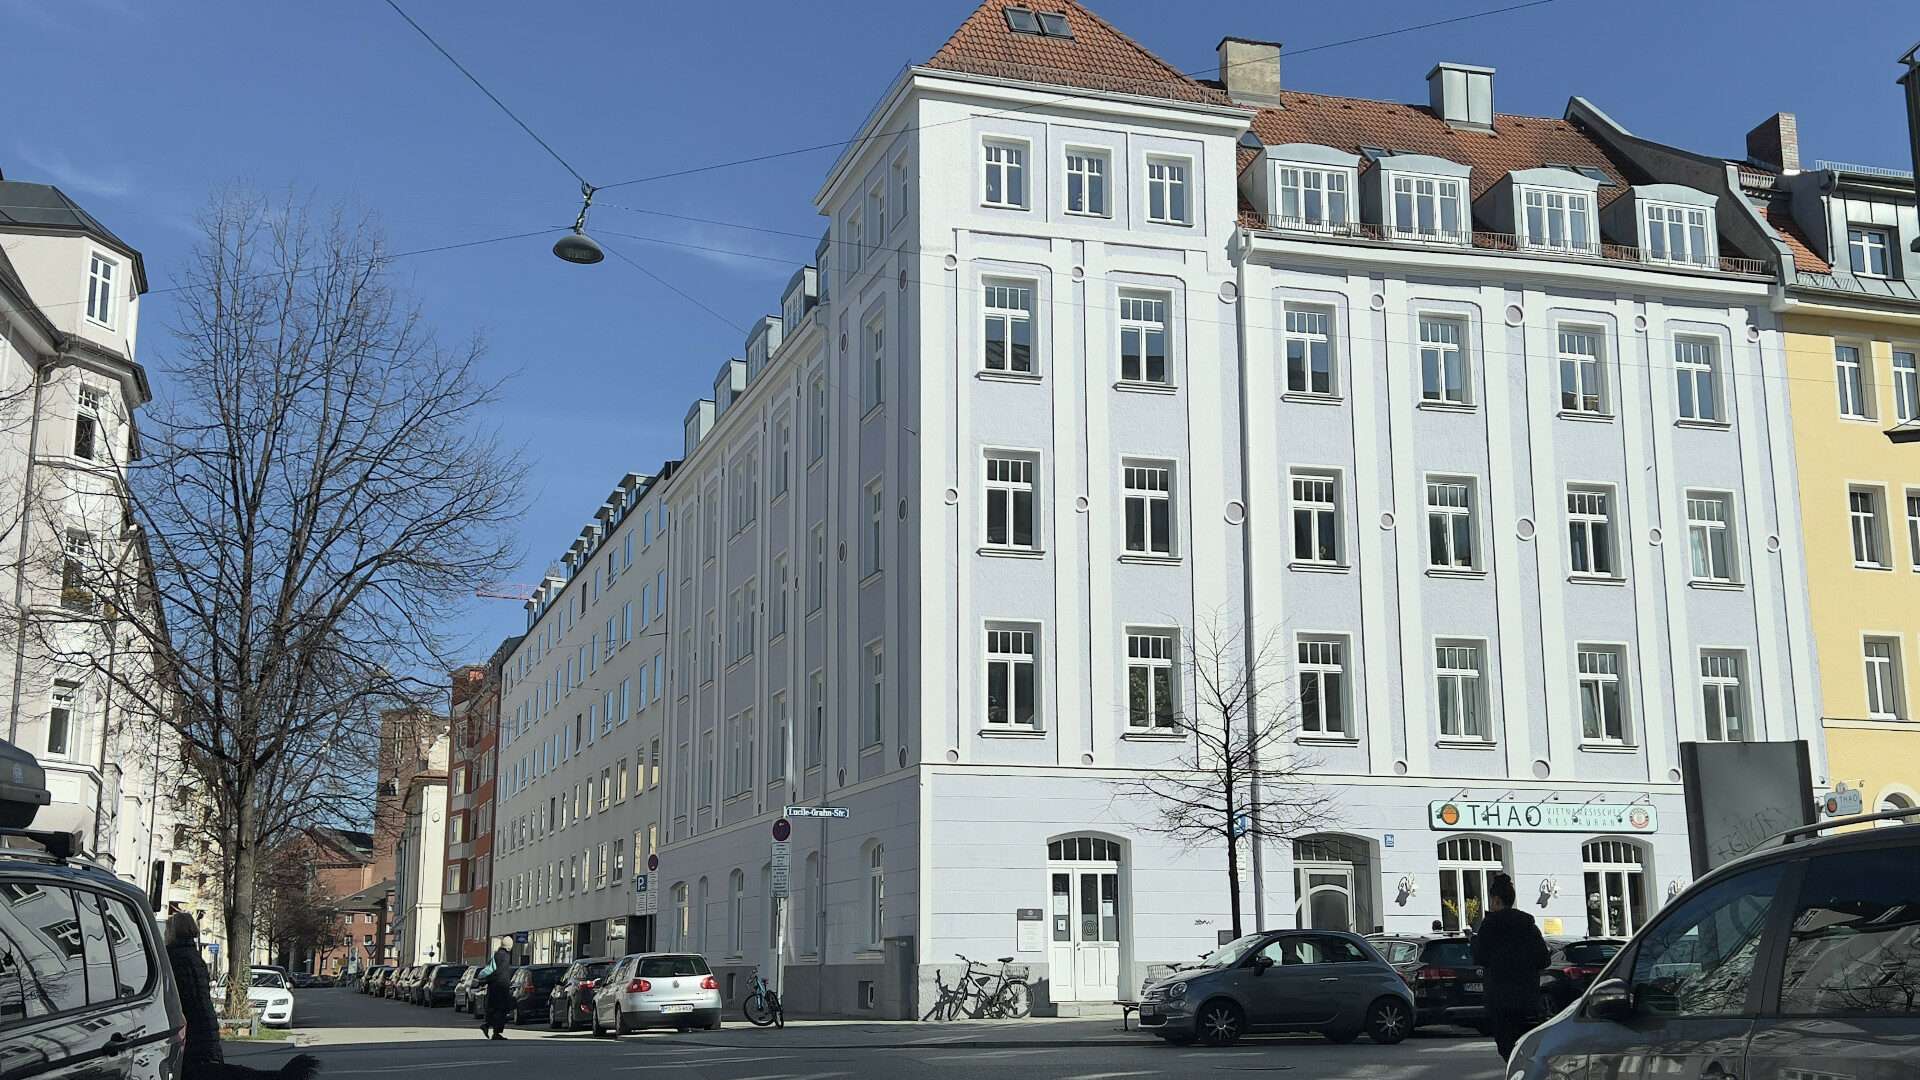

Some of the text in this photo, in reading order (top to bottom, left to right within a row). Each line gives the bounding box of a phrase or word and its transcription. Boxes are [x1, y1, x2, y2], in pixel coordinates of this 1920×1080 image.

[788, 808, 846, 817] Lucile-Grahn-Str.
[1467, 804, 1541, 827] THAO
[1546, 817, 1623, 826] RESAURAN
